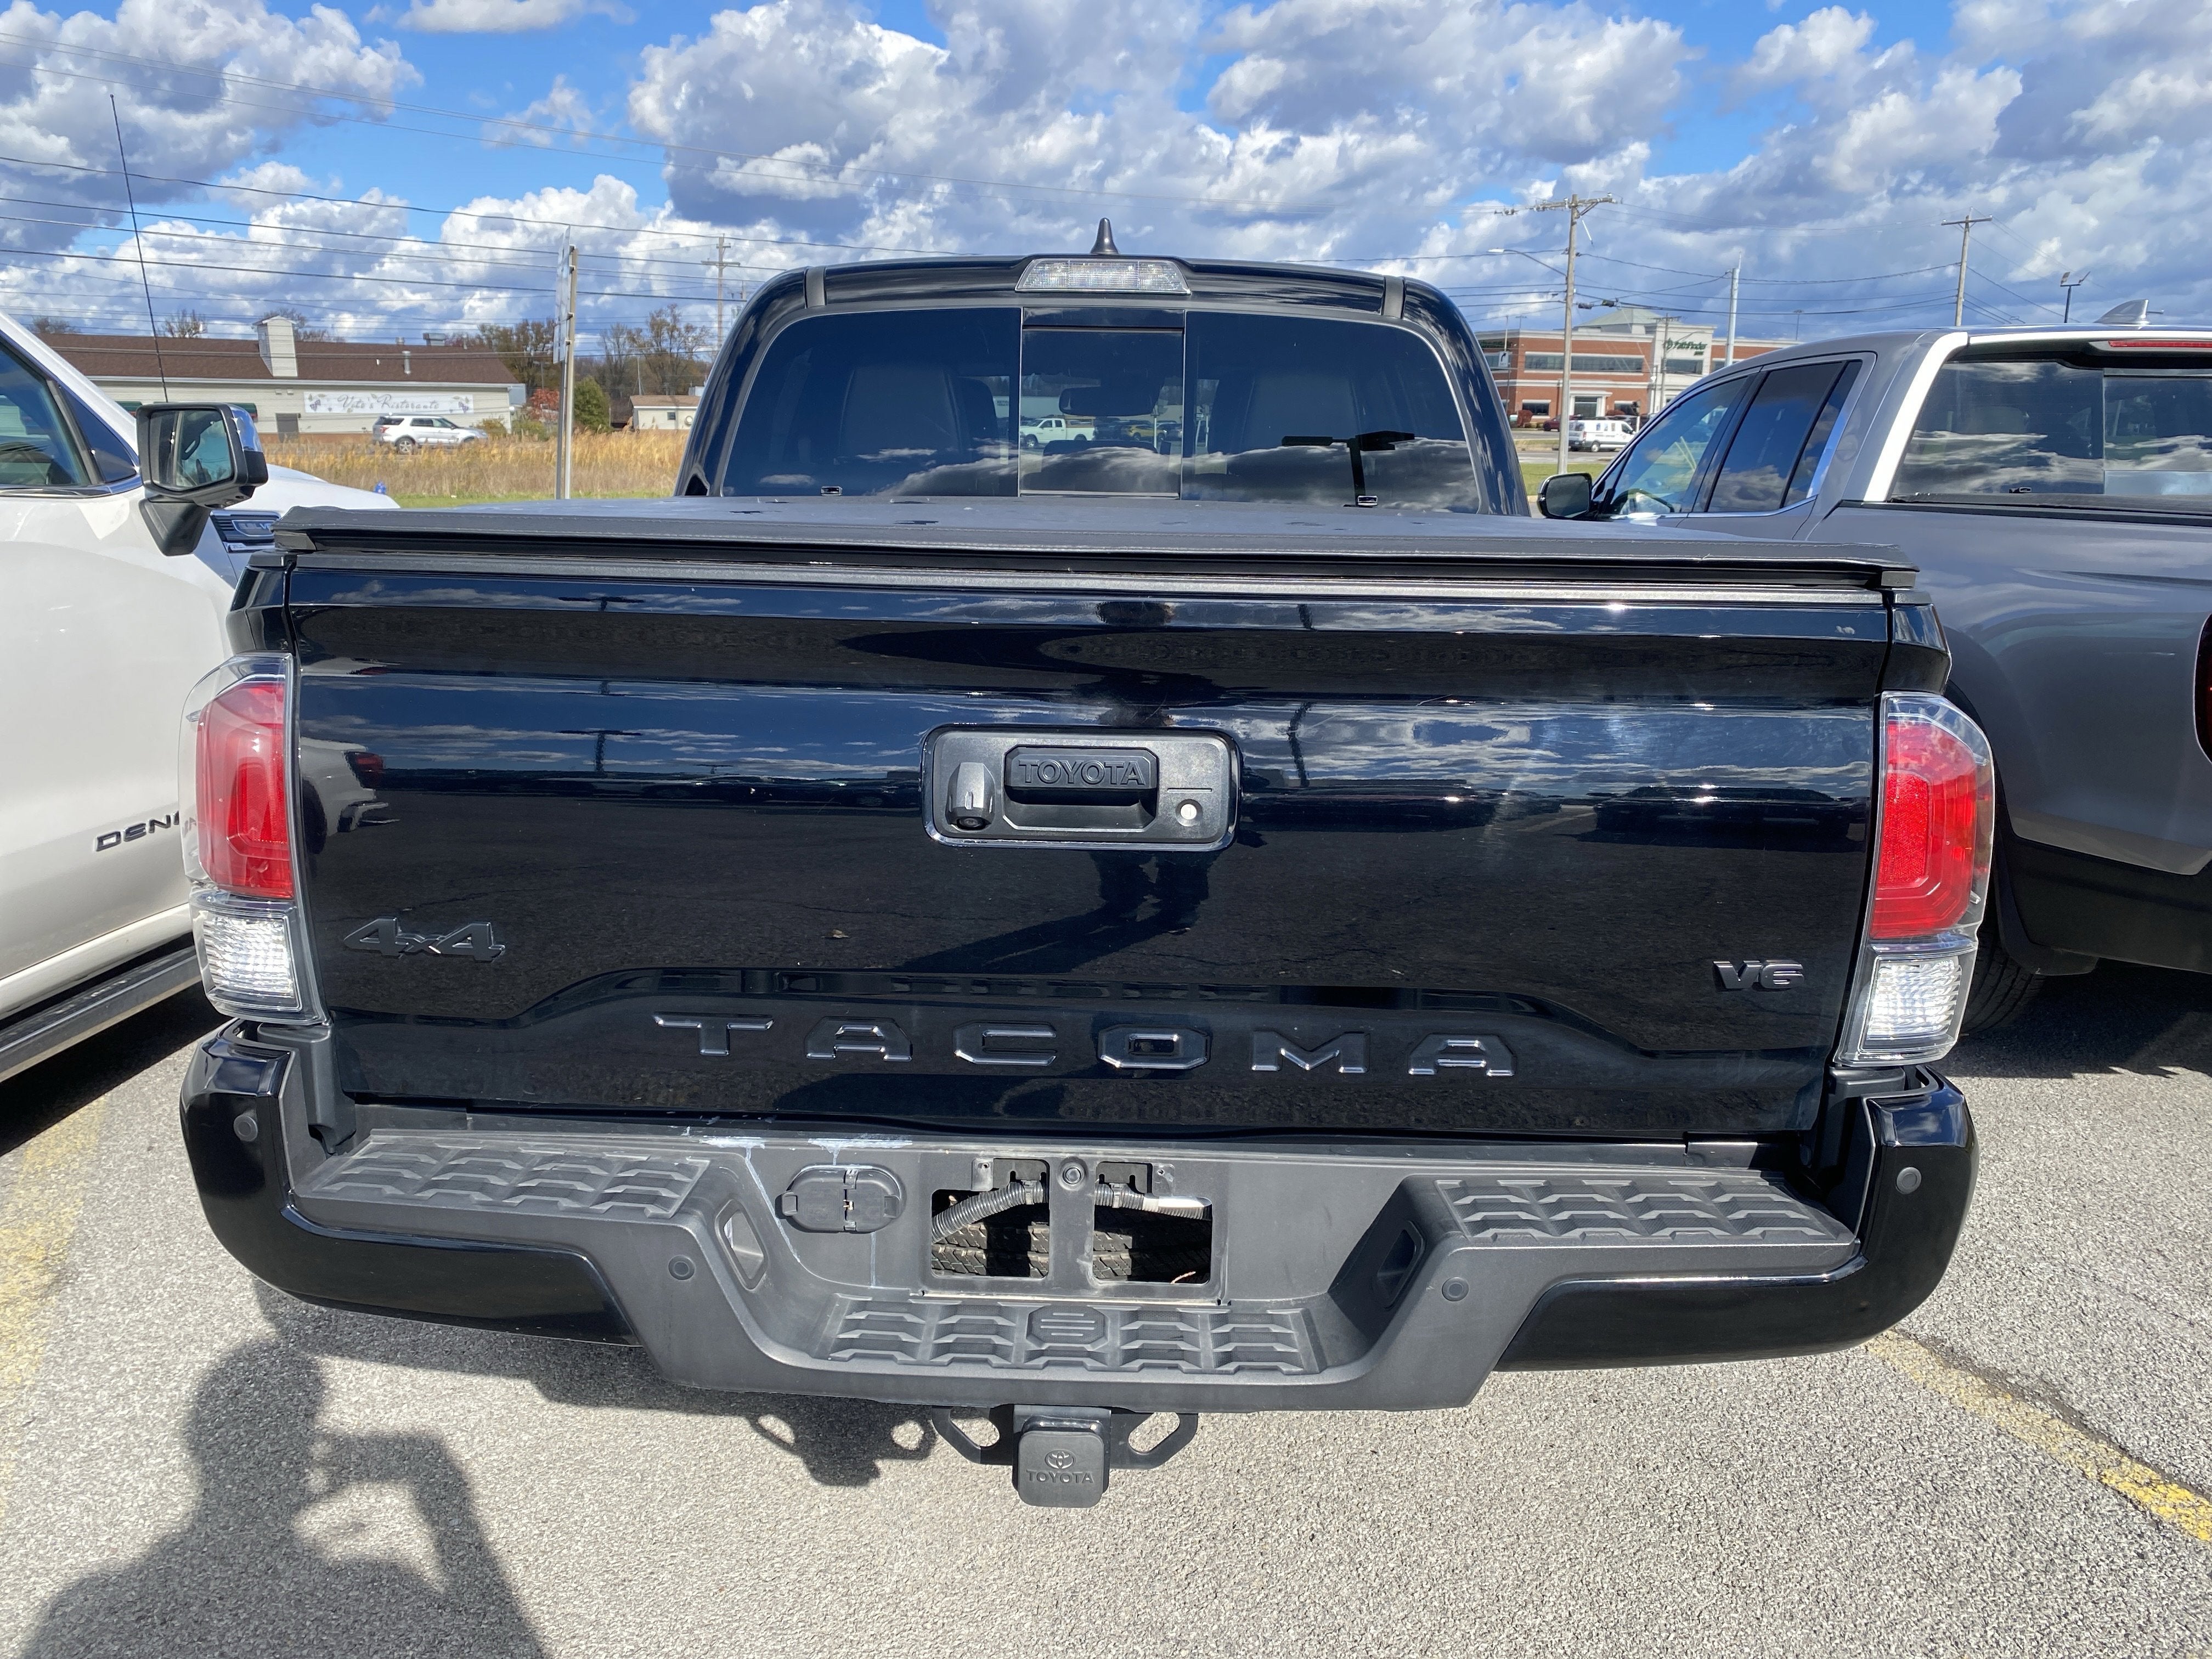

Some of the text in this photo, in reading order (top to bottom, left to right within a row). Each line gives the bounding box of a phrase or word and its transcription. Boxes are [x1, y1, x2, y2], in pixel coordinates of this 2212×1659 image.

[337, 393, 439, 409] Vito's Ristorante
[1018, 759, 1146, 786] TOYOTA
[342, 916, 506, 963] 4x4
[1712, 960, 1805, 991] V6
[654, 1012, 1517, 1077] TACOMA
[1026, 1469, 1094, 1483] TOYOTA
